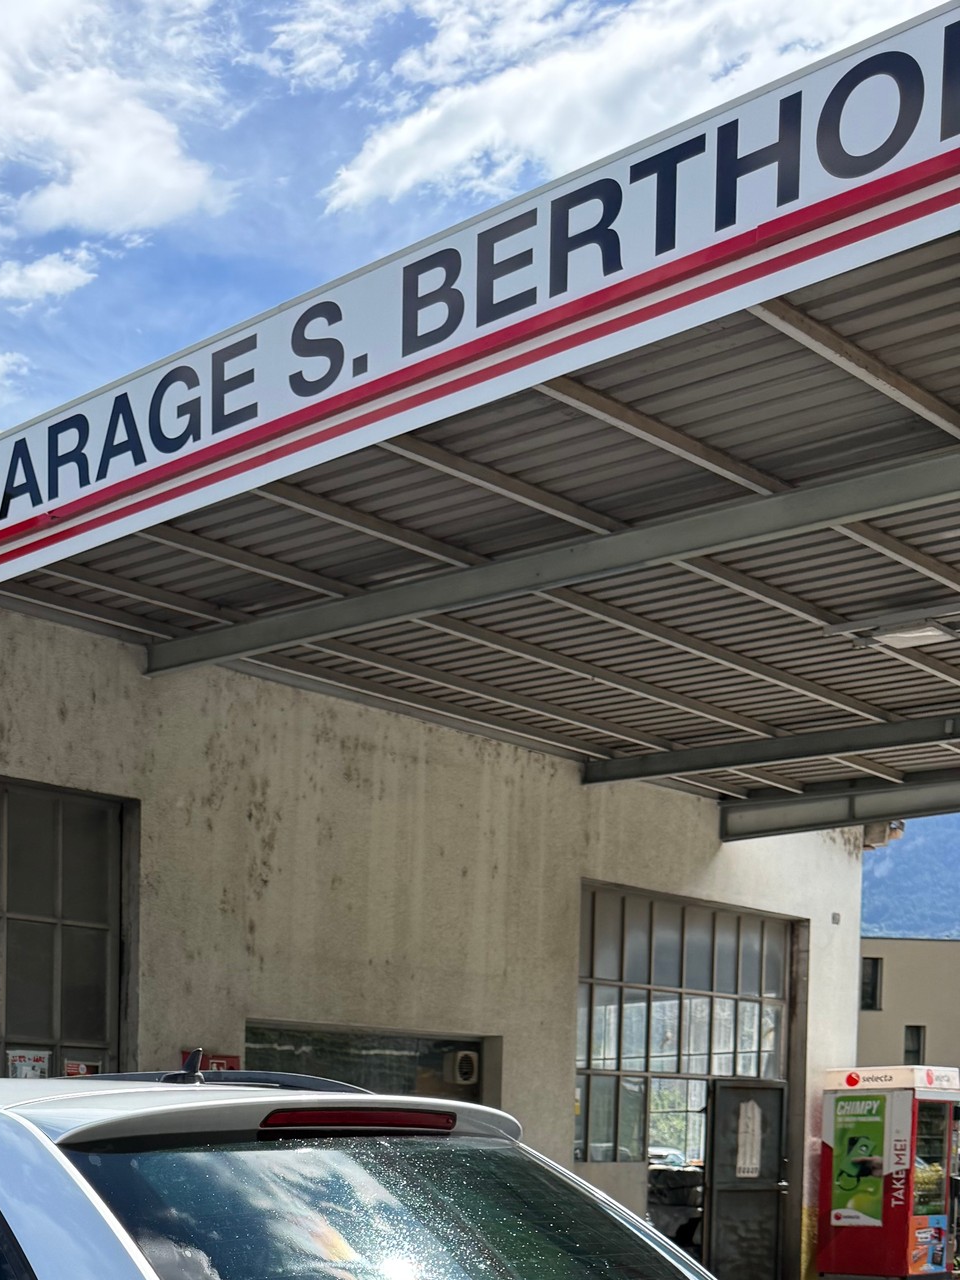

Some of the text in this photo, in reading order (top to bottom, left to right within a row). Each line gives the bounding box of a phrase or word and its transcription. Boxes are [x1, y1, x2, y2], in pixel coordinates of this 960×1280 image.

[288, 301, 368, 399] S.
[862, 1075, 893, 1083] selecta
[836, 1100, 880, 1115] CHIMPY
[891, 1138, 907, 1208] TAKE ME!
